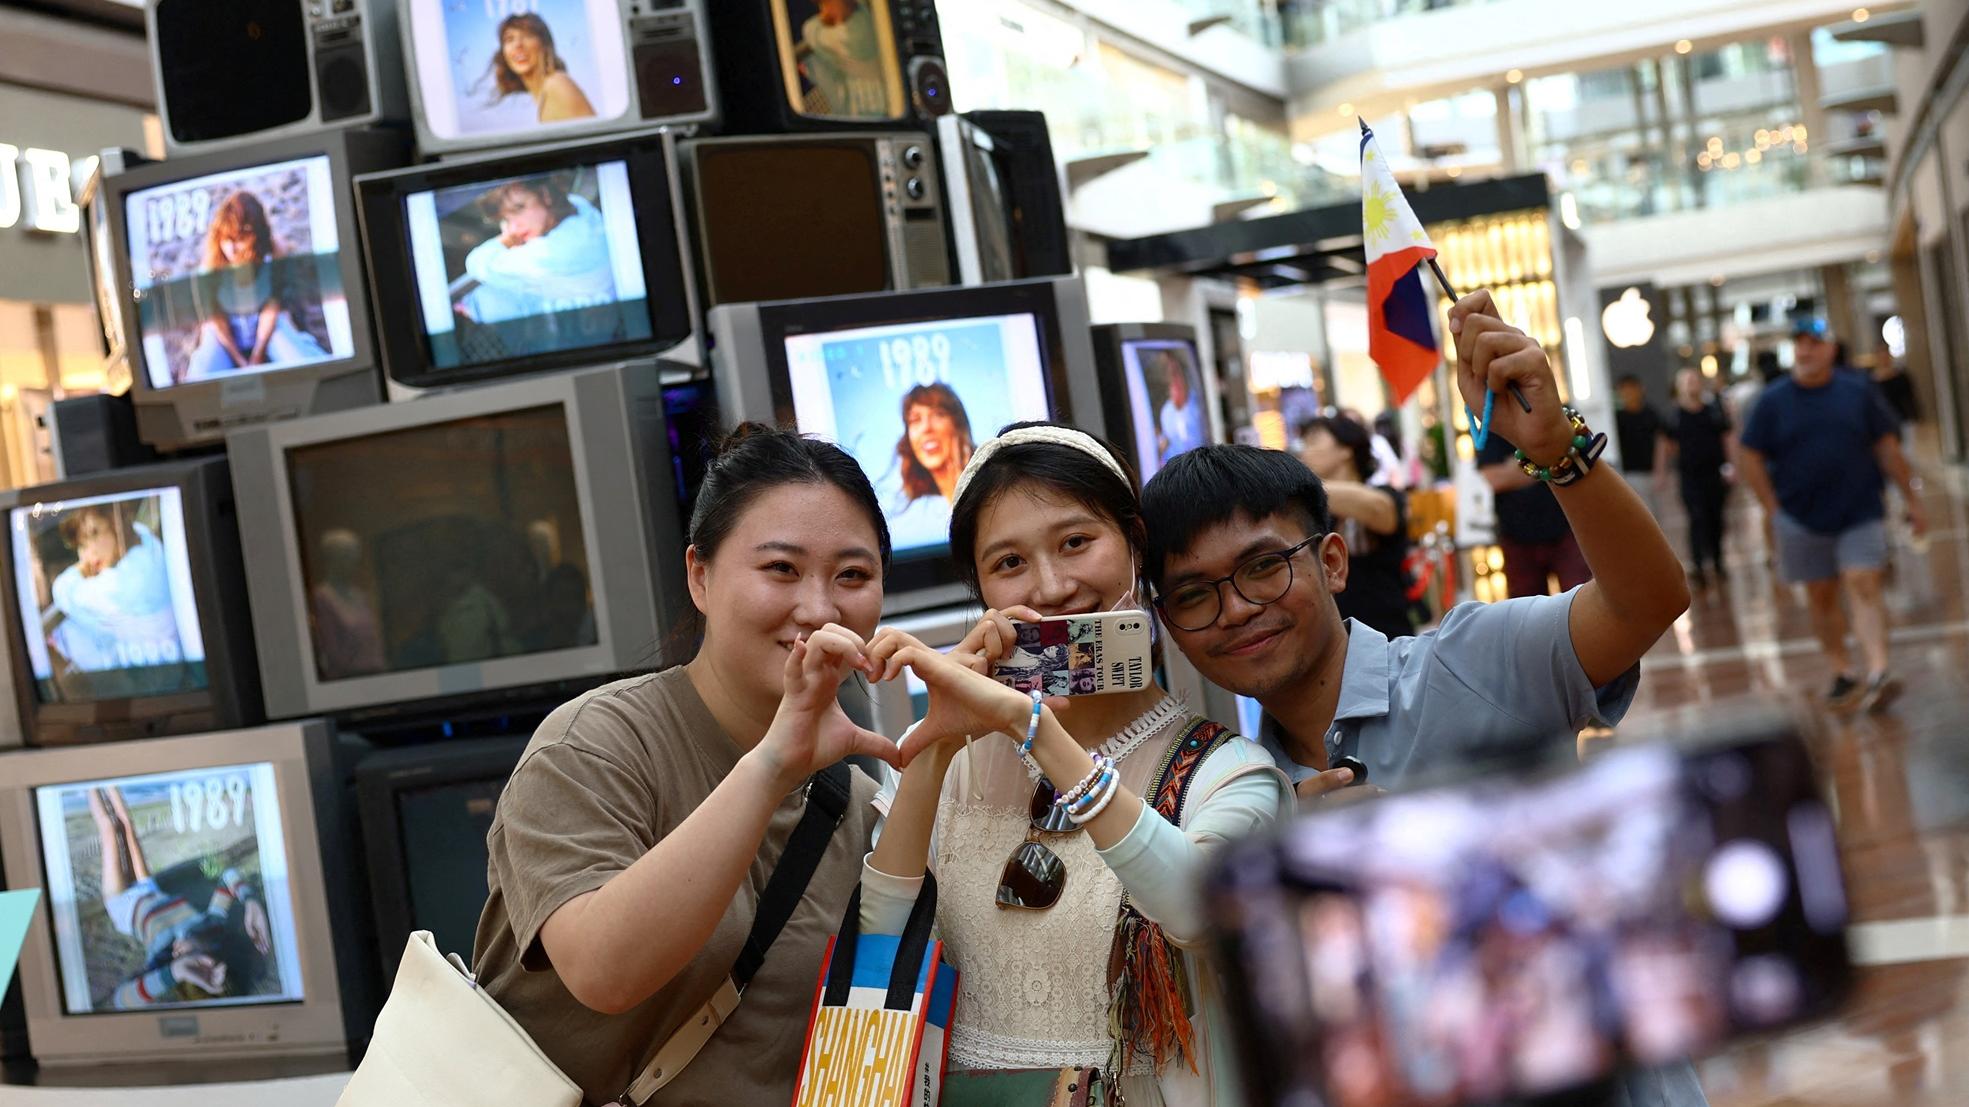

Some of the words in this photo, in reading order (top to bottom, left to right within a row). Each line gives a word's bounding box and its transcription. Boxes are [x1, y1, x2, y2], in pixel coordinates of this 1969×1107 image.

[147, 188, 209, 243] 1989
[879, 332, 950, 390] 1989
[1097, 666, 1105, 690] TOUR
[1112, 662, 1125, 686] SWIFT
[1129, 656, 1142, 688] TAYLOR
[170, 775, 245, 833] 1989
[797, 1007, 918, 1107] SHANGHAI
